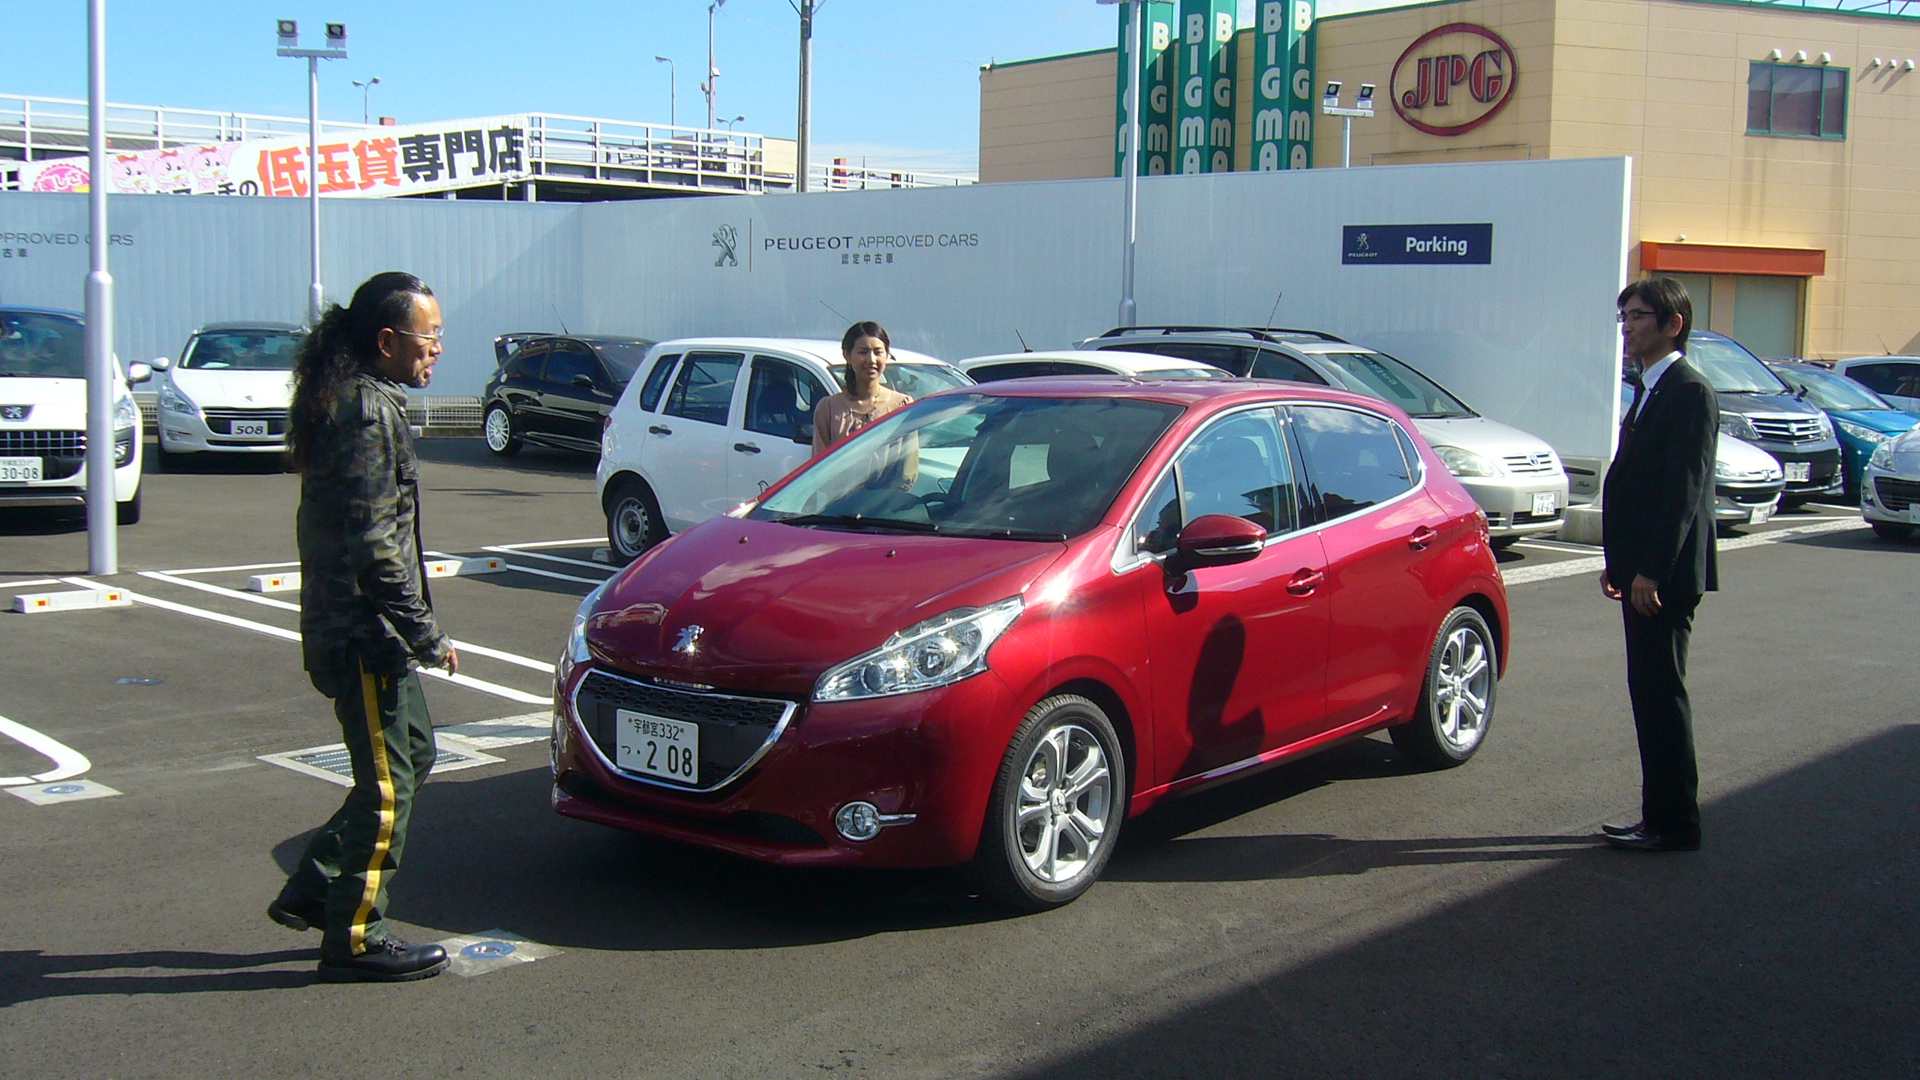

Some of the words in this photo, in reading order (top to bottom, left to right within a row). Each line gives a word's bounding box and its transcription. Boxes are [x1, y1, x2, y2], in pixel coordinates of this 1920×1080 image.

[1401, 50, 1503, 110] JPG
[0, 232, 79, 246] PROVED
[84, 233, 135, 247] CRS
[764, 236, 853, 250] PEUGEOT
[857, 234, 934, 249] APPROVED
[938, 233, 979, 248] CARS
[1405, 236, 1468, 256] Parking
[235, 425, 264, 435] 508
[1, 467, 39, 480] 30-08
